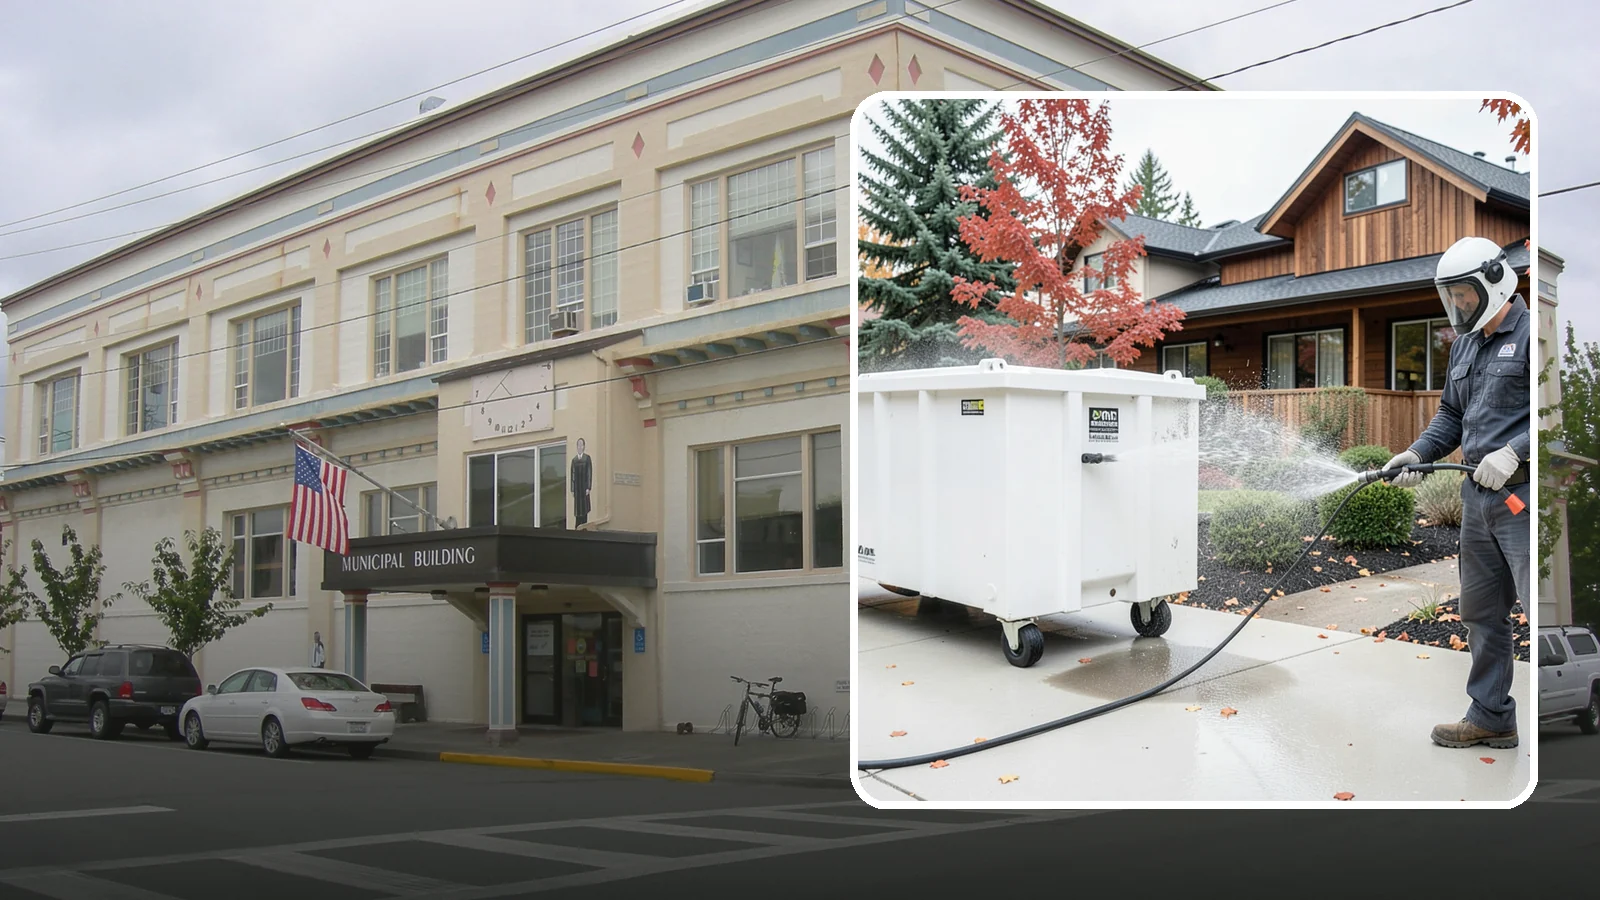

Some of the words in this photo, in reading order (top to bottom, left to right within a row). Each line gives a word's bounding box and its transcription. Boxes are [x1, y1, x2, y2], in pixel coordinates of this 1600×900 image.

[481, 407, 485, 415] 8
[488, 418, 492, 426] 9
[529, 414, 533, 422] 3
[342, 552, 405, 572] MUNICIPAL
[414, 546, 475, 567] BUILDING
